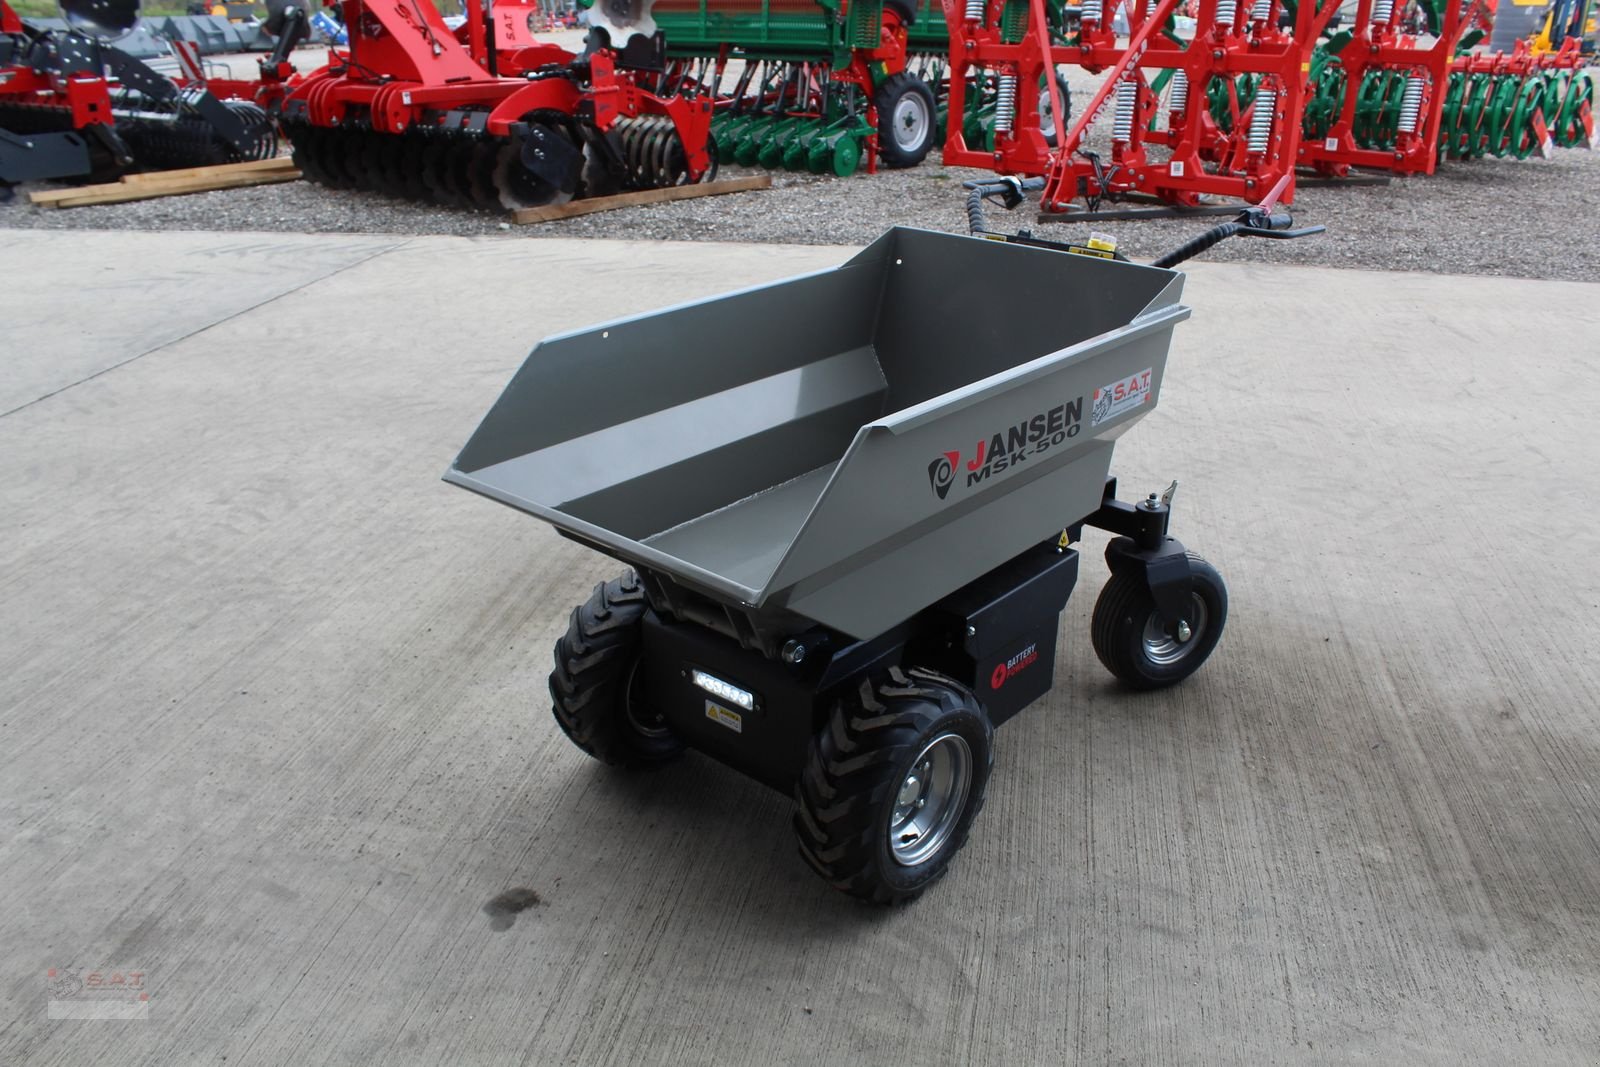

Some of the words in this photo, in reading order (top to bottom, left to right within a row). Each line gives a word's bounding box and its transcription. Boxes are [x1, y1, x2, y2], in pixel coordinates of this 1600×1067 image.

[967, 397, 1083, 471] JANSEN
[967, 424, 1080, 488] MSK-500
[1007, 643, 1036, 670] BATTERY
